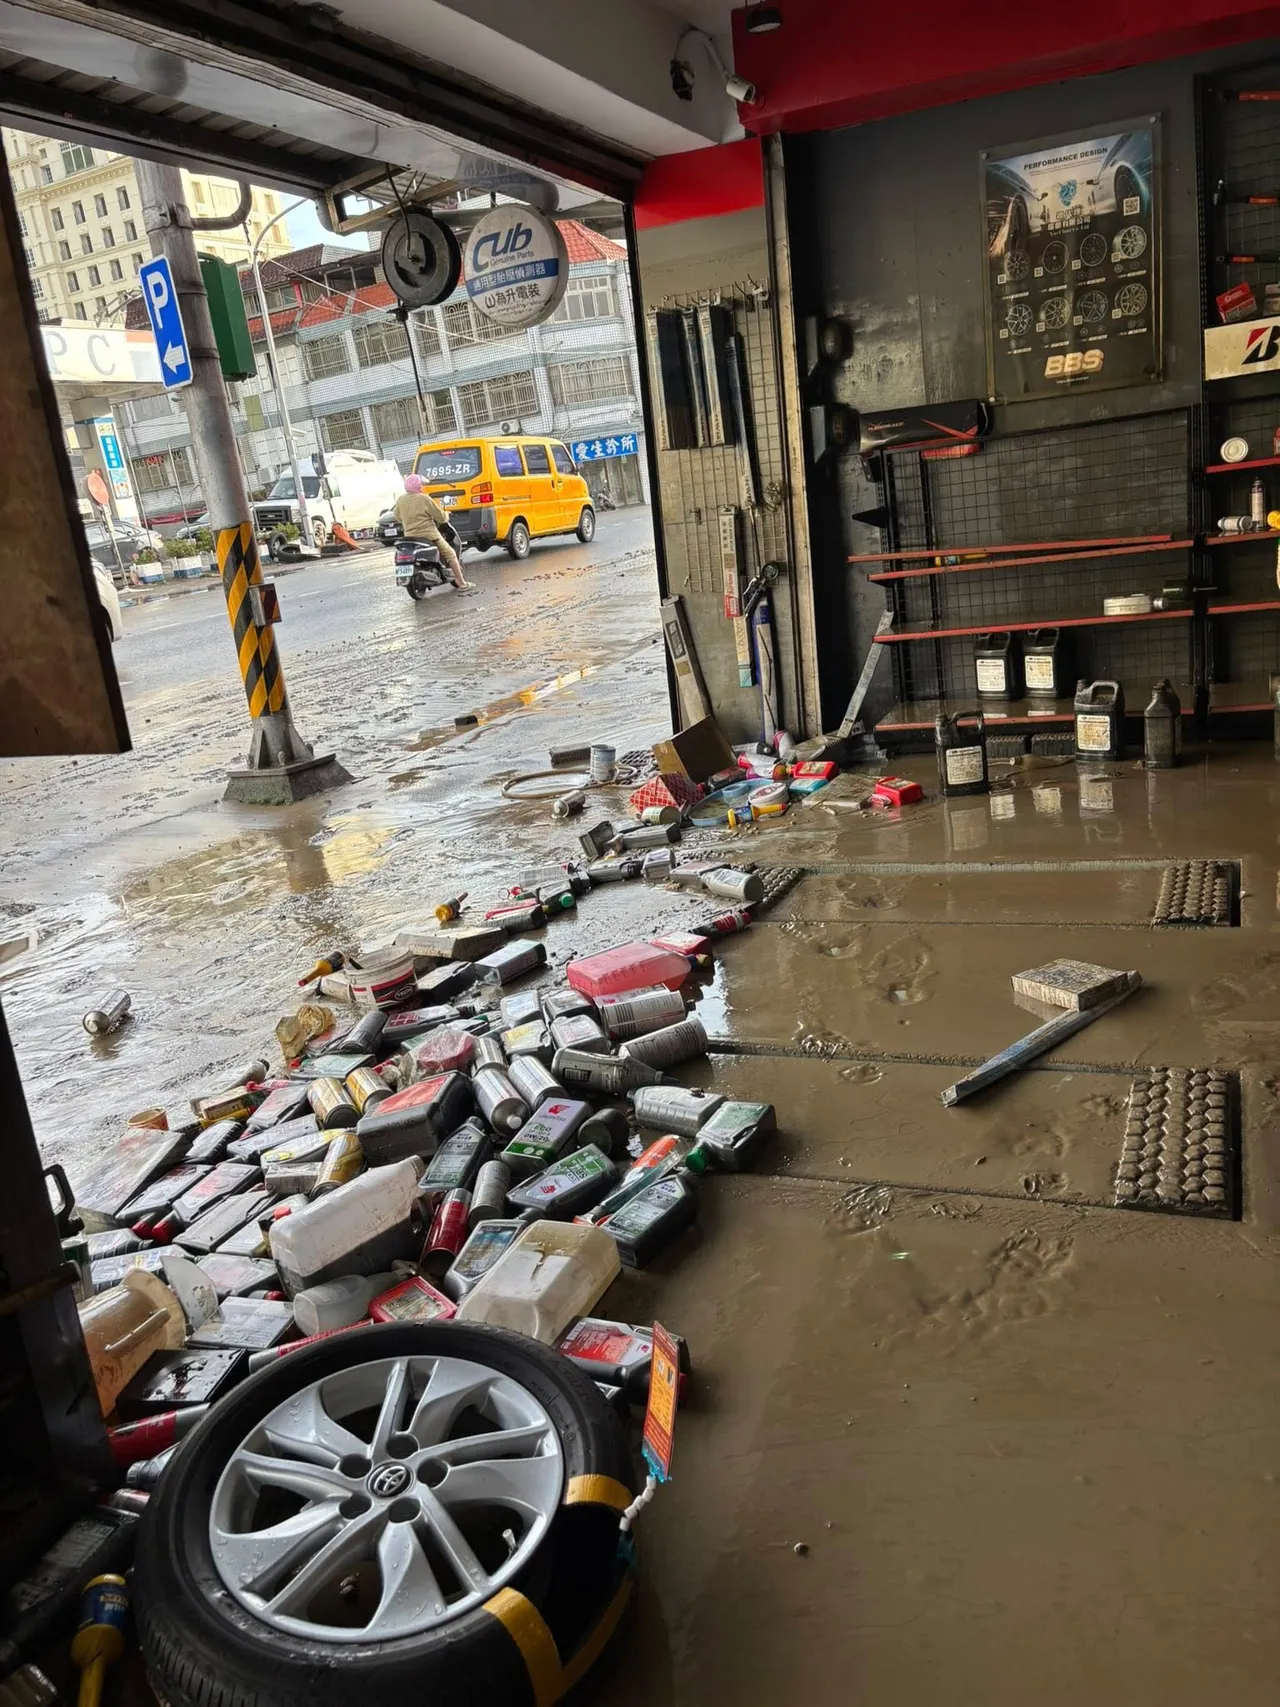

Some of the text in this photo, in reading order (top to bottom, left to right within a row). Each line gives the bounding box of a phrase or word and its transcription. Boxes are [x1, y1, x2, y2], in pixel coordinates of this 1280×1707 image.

[1023, 153, 1078, 171] PERFORMANCE
[1079, 147, 1108, 158] DESIGN
[516, 249, 535, 260] Parts
[146, 271, 169, 329] P
[1044, 348, 1105, 379] BBS
[575, 434, 635, 460] 愛生診所
[426, 463, 471, 478] 7695-ZR
